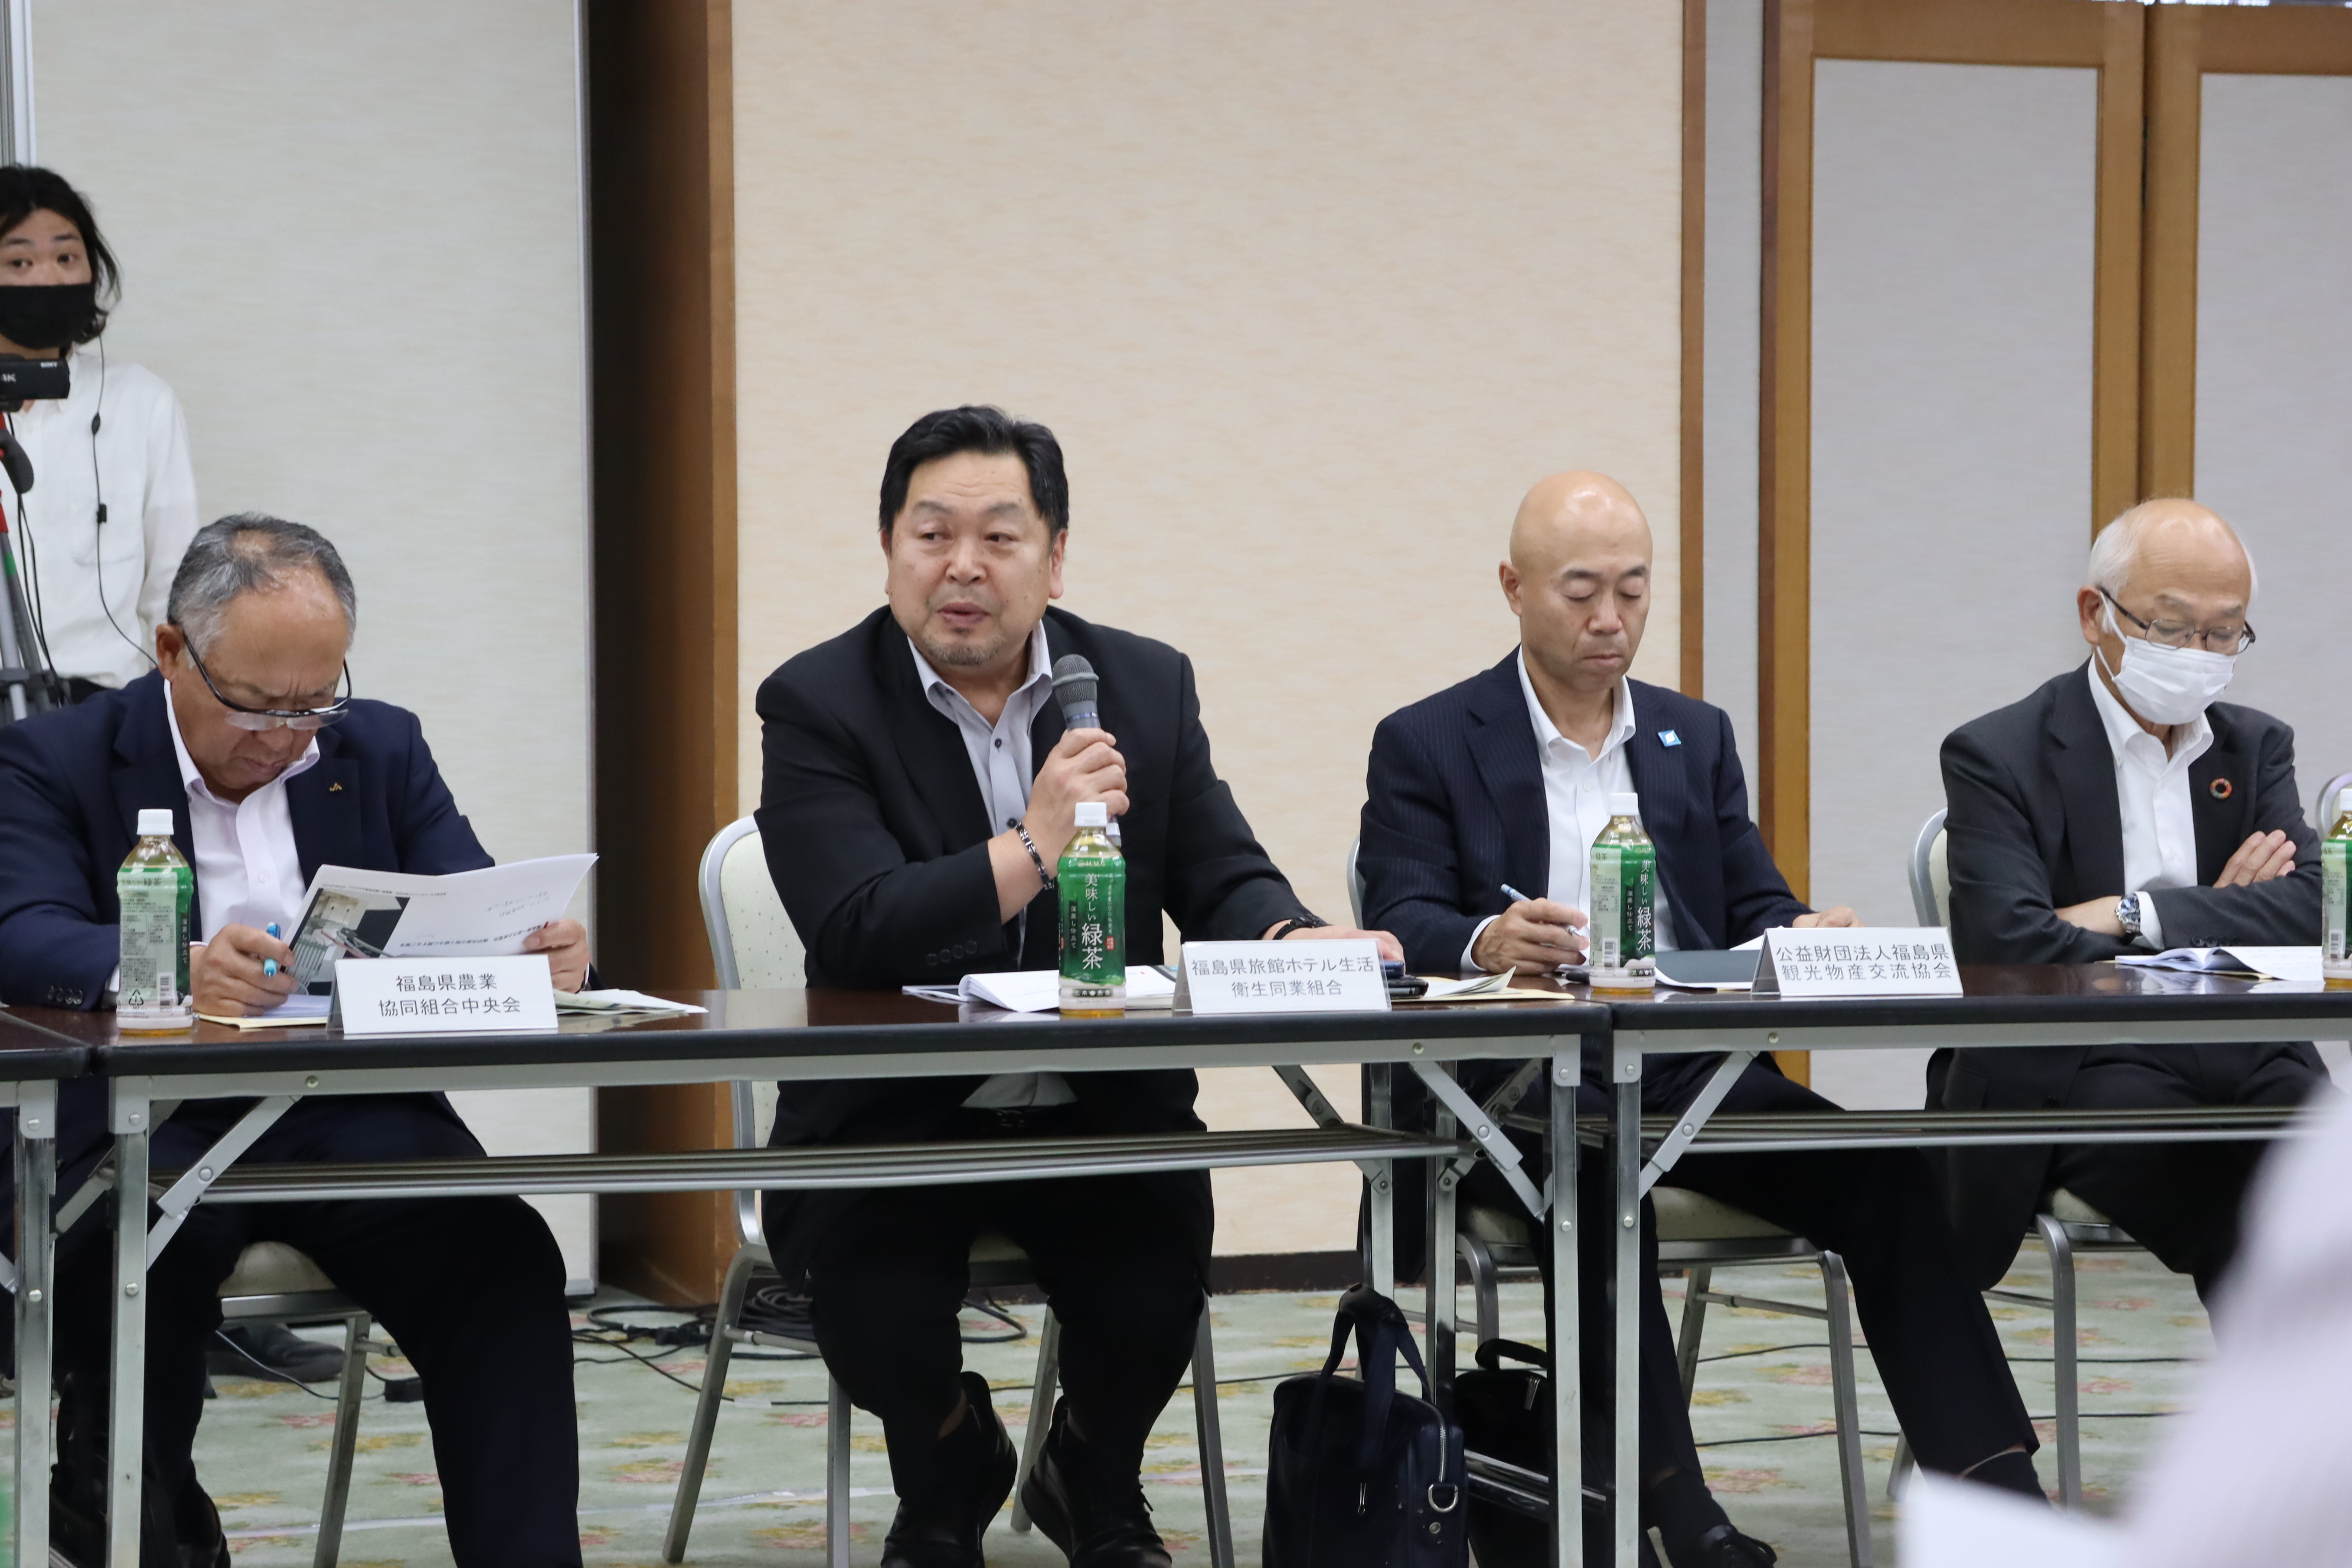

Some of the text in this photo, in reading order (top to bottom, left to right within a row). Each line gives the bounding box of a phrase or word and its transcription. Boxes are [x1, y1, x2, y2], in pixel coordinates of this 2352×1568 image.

[1638, 860, 1652, 951] 美味しい緑茶
[1082, 873, 1103, 970] 美味しい緑茶
[1776, 943, 1949, 962] 公益財団法人福島県
[1191, 956, 1374, 976] 福島県旅館ホテル生活
[1782, 962, 1951, 981] 観光物産交流協会
[396, 973, 497, 992] 福島県農業
[1231, 980, 1342, 998] 衛生同業組合
[378, 997, 520, 1017] 協同組合中央会
